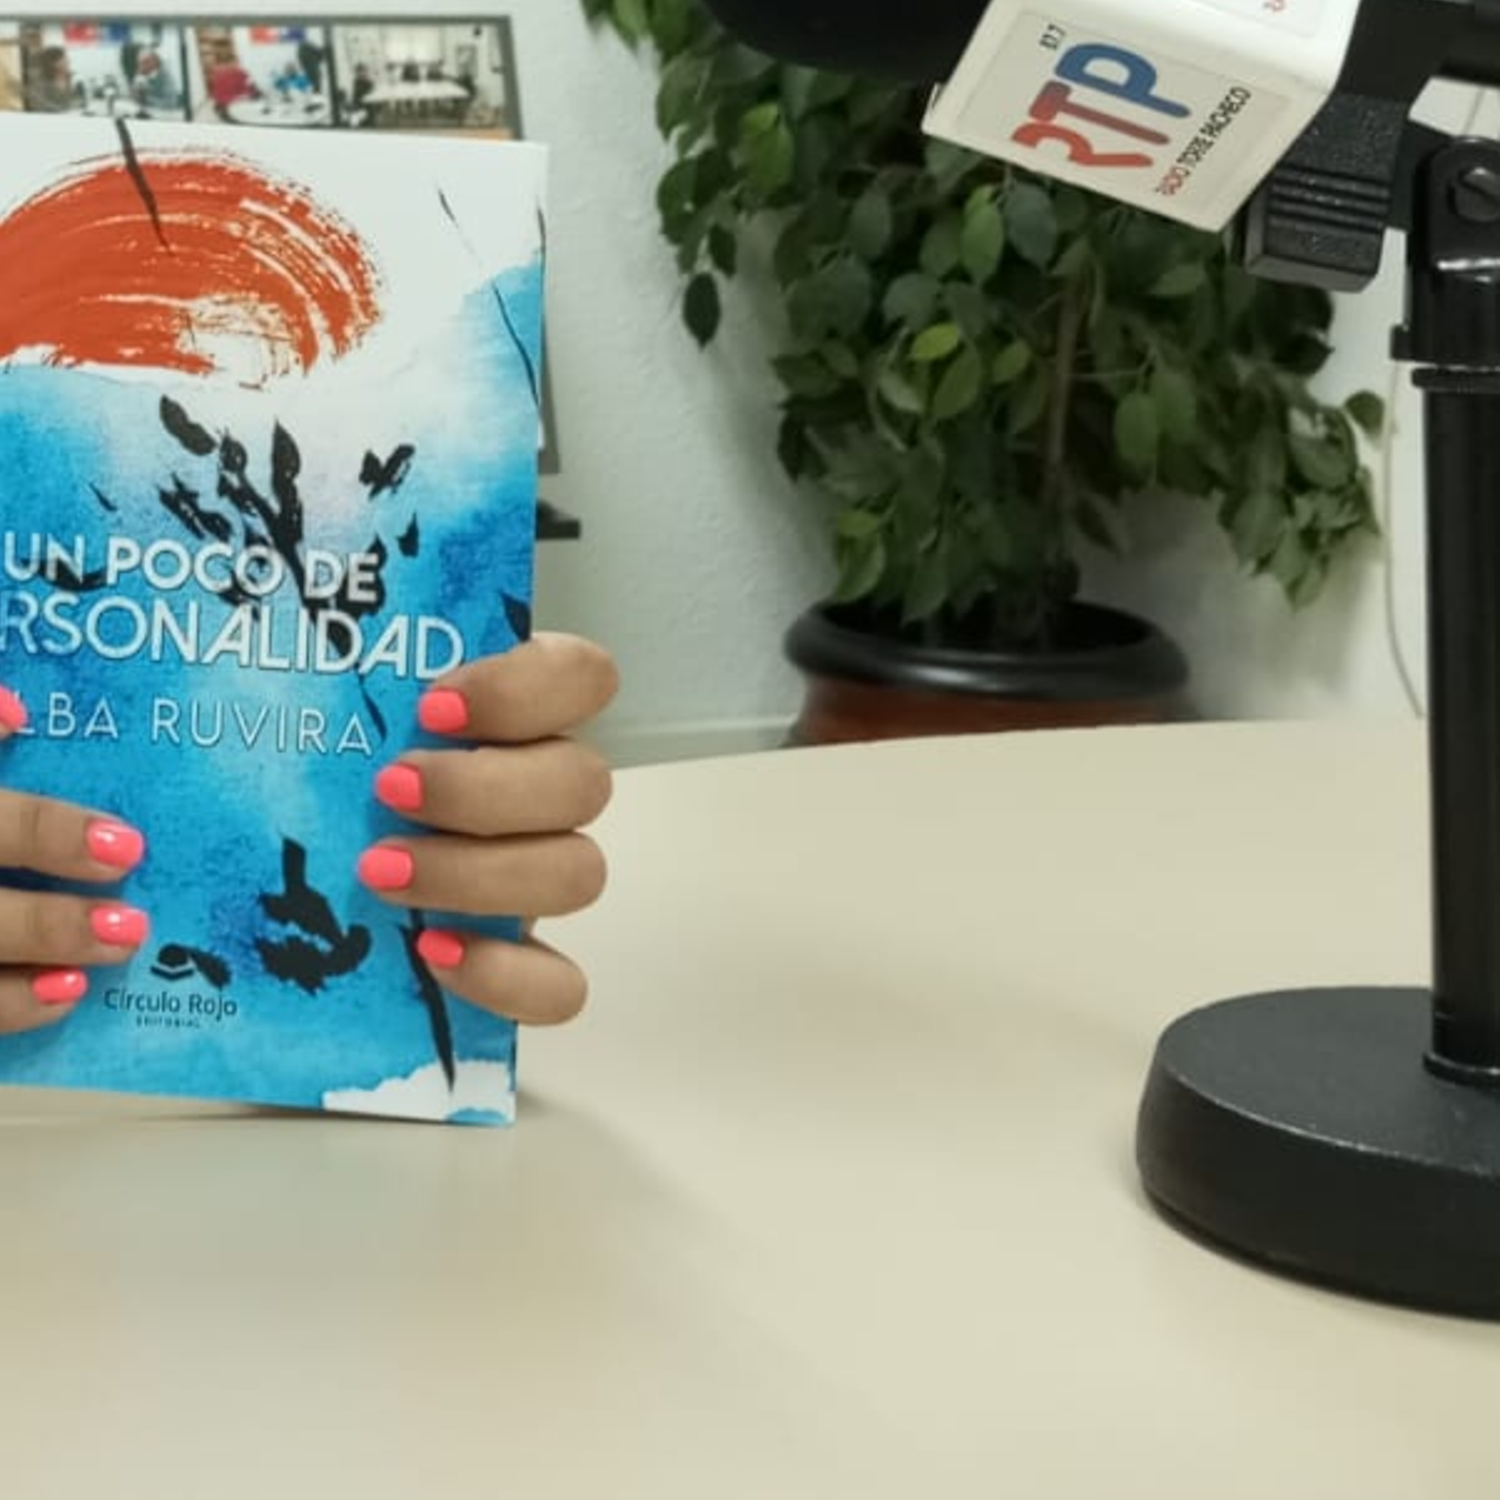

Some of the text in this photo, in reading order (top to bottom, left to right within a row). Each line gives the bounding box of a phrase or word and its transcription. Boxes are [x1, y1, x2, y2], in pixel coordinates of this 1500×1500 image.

[1010, 43, 1192, 168] RTP
[1199, 86, 1252, 139] PACHECO
[4, 530, 380, 603] UN POCO DE
[150, 699, 373, 755] RUVIRA
[103, 985, 238, 1021] Círculo Rojo
